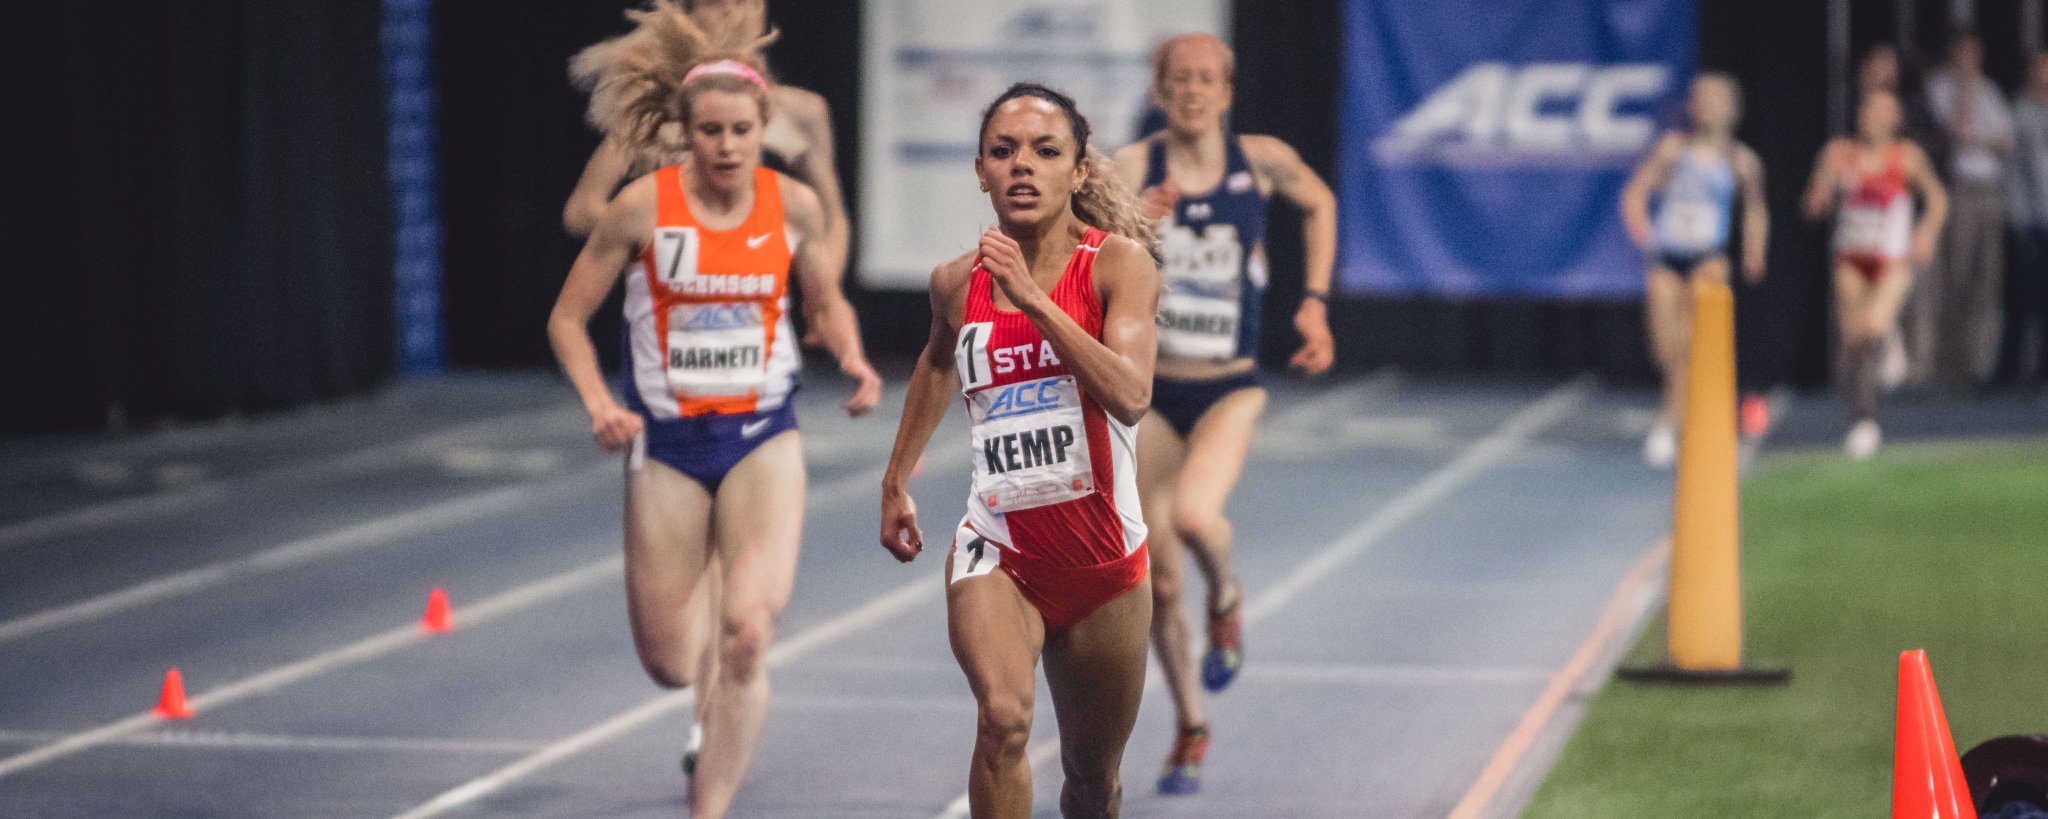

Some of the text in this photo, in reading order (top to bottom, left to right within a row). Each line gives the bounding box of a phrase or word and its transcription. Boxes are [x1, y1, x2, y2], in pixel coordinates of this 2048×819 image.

[1372, 61, 1672, 156] ACC
[663, 231, 686, 279] 7
[670, 345, 761, 370] BARNETT
[962, 326, 978, 384] 1
[985, 378, 1061, 419] ACC
[984, 424, 1075, 476] KEMP
